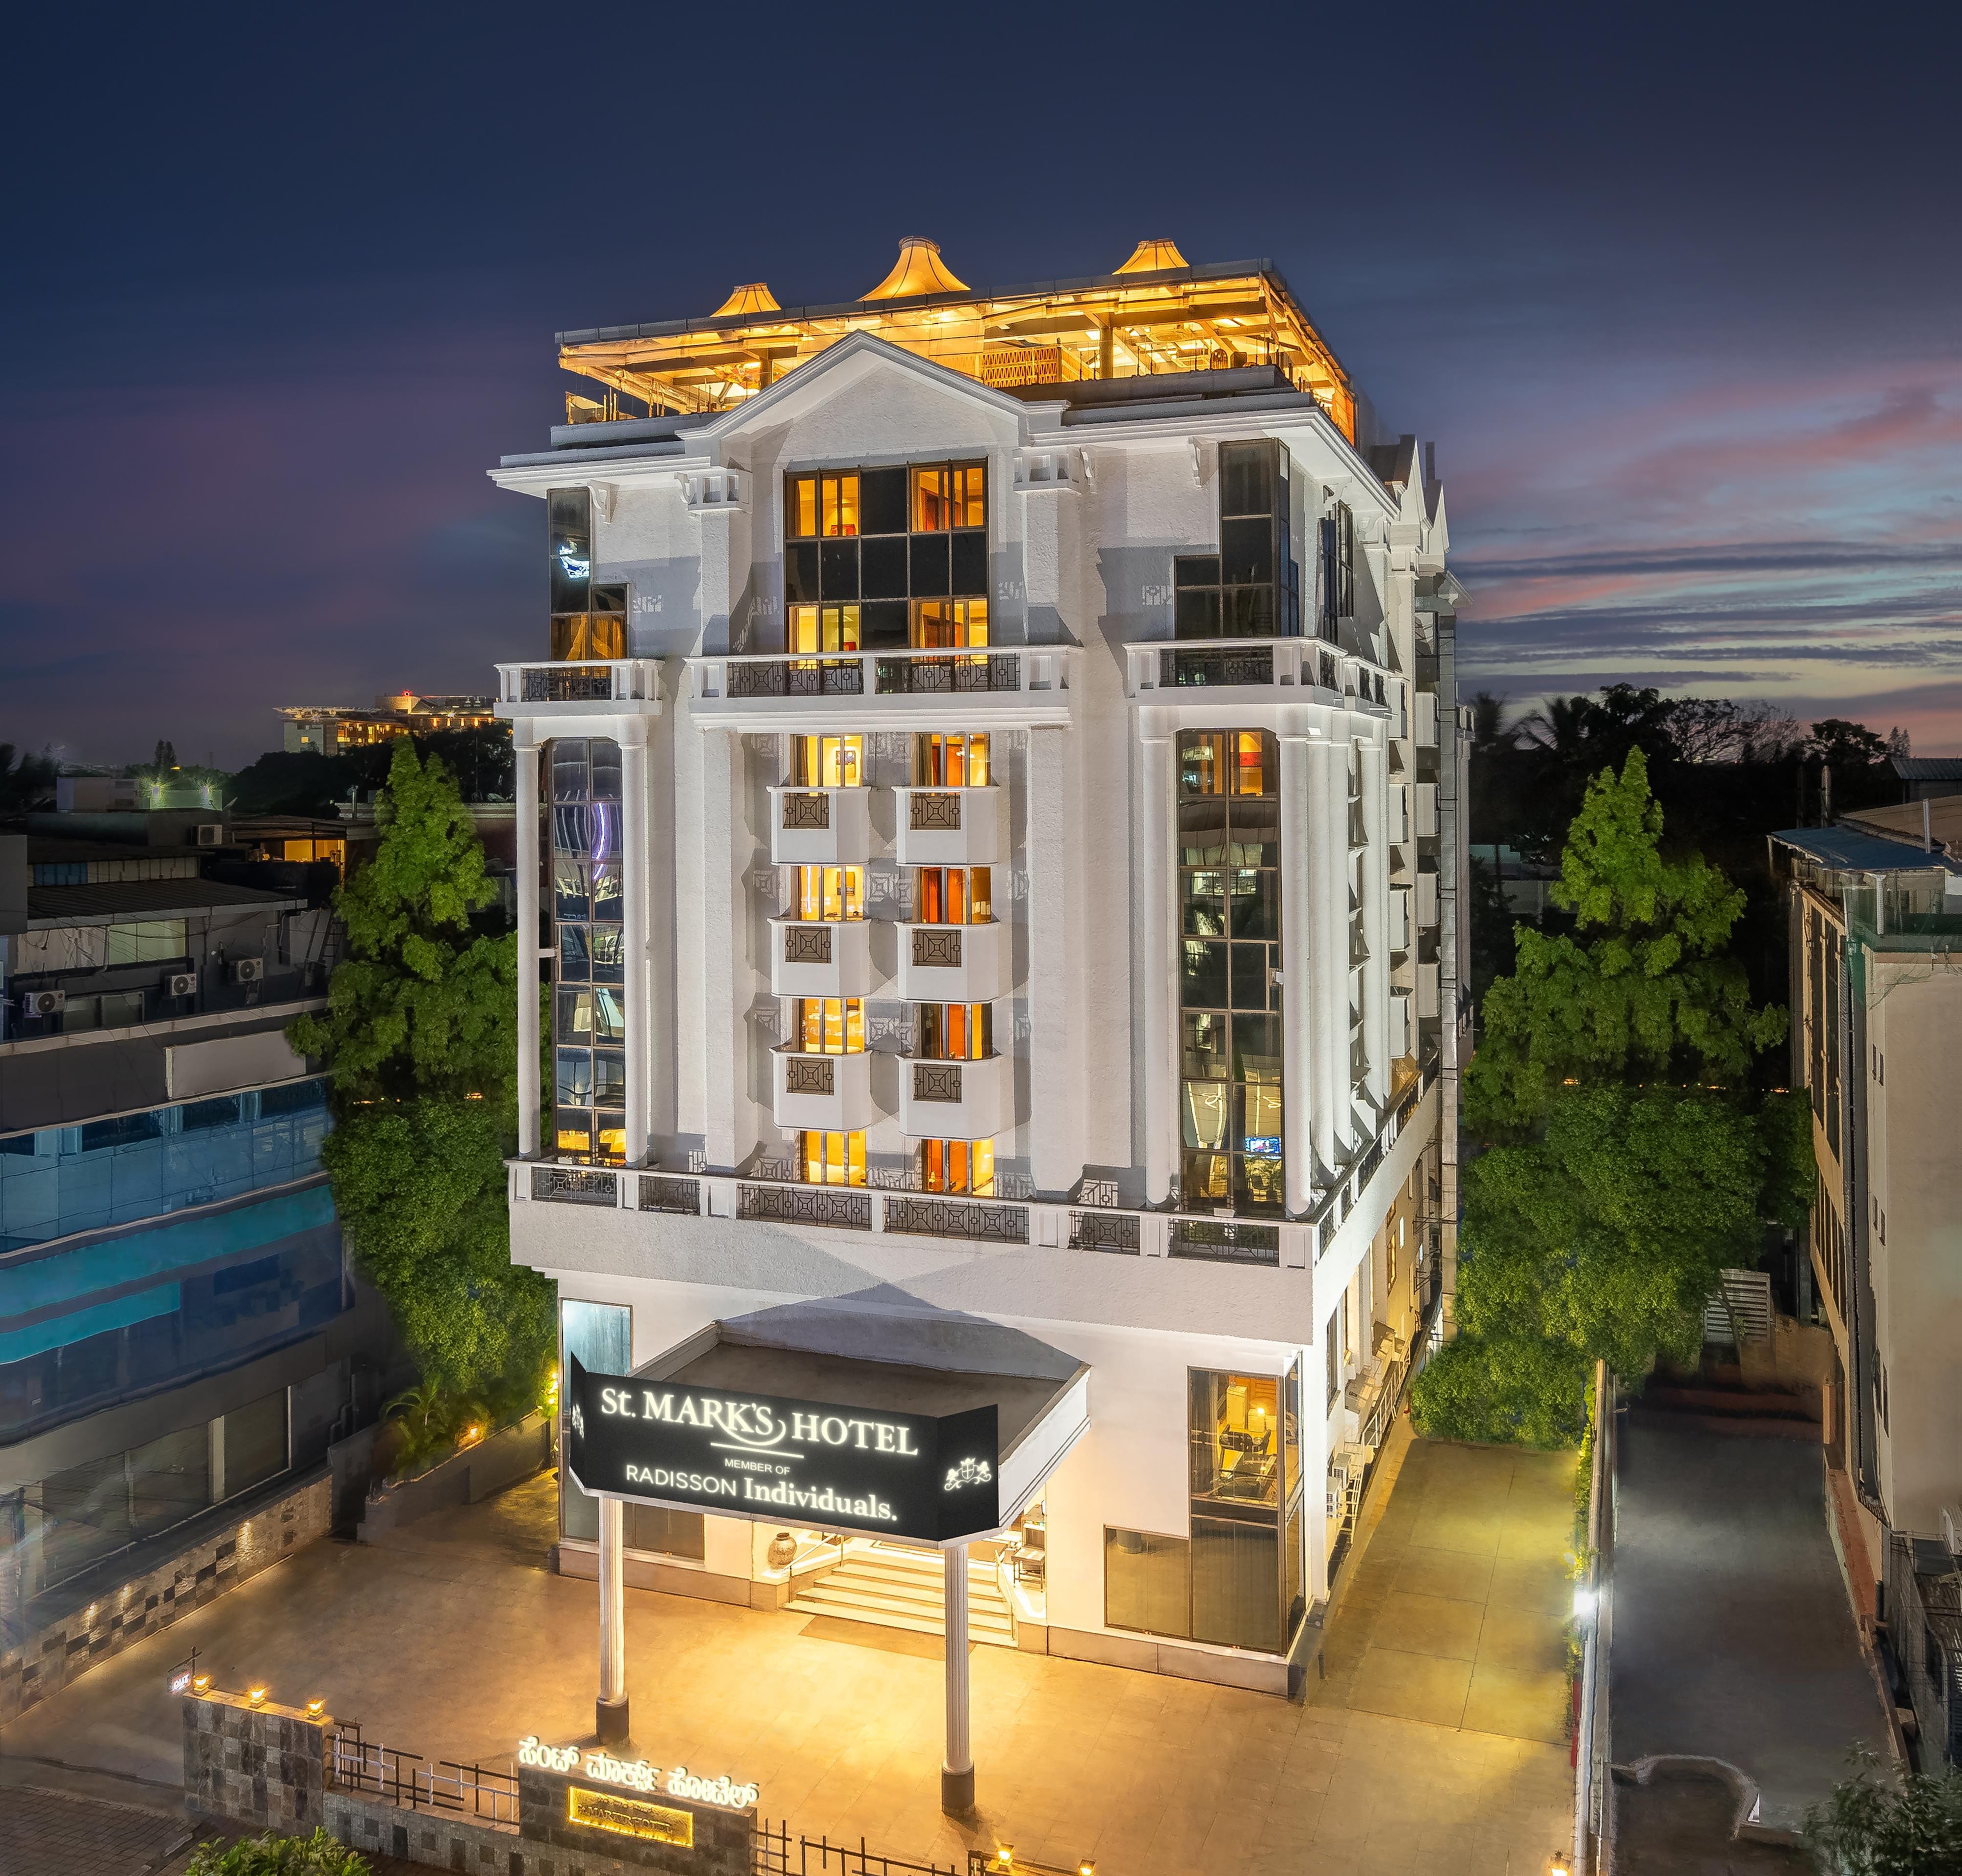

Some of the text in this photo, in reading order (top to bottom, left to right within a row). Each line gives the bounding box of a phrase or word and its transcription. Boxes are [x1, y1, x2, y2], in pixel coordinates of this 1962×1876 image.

[601, 1388, 918, 1456] St. MARK'S HOTEL
[724, 1458, 791, 1475] MEMBER OF
[626, 1465, 897, 1521] RADISSON Individuals.
[173, 1673, 189, 1690] OUT
